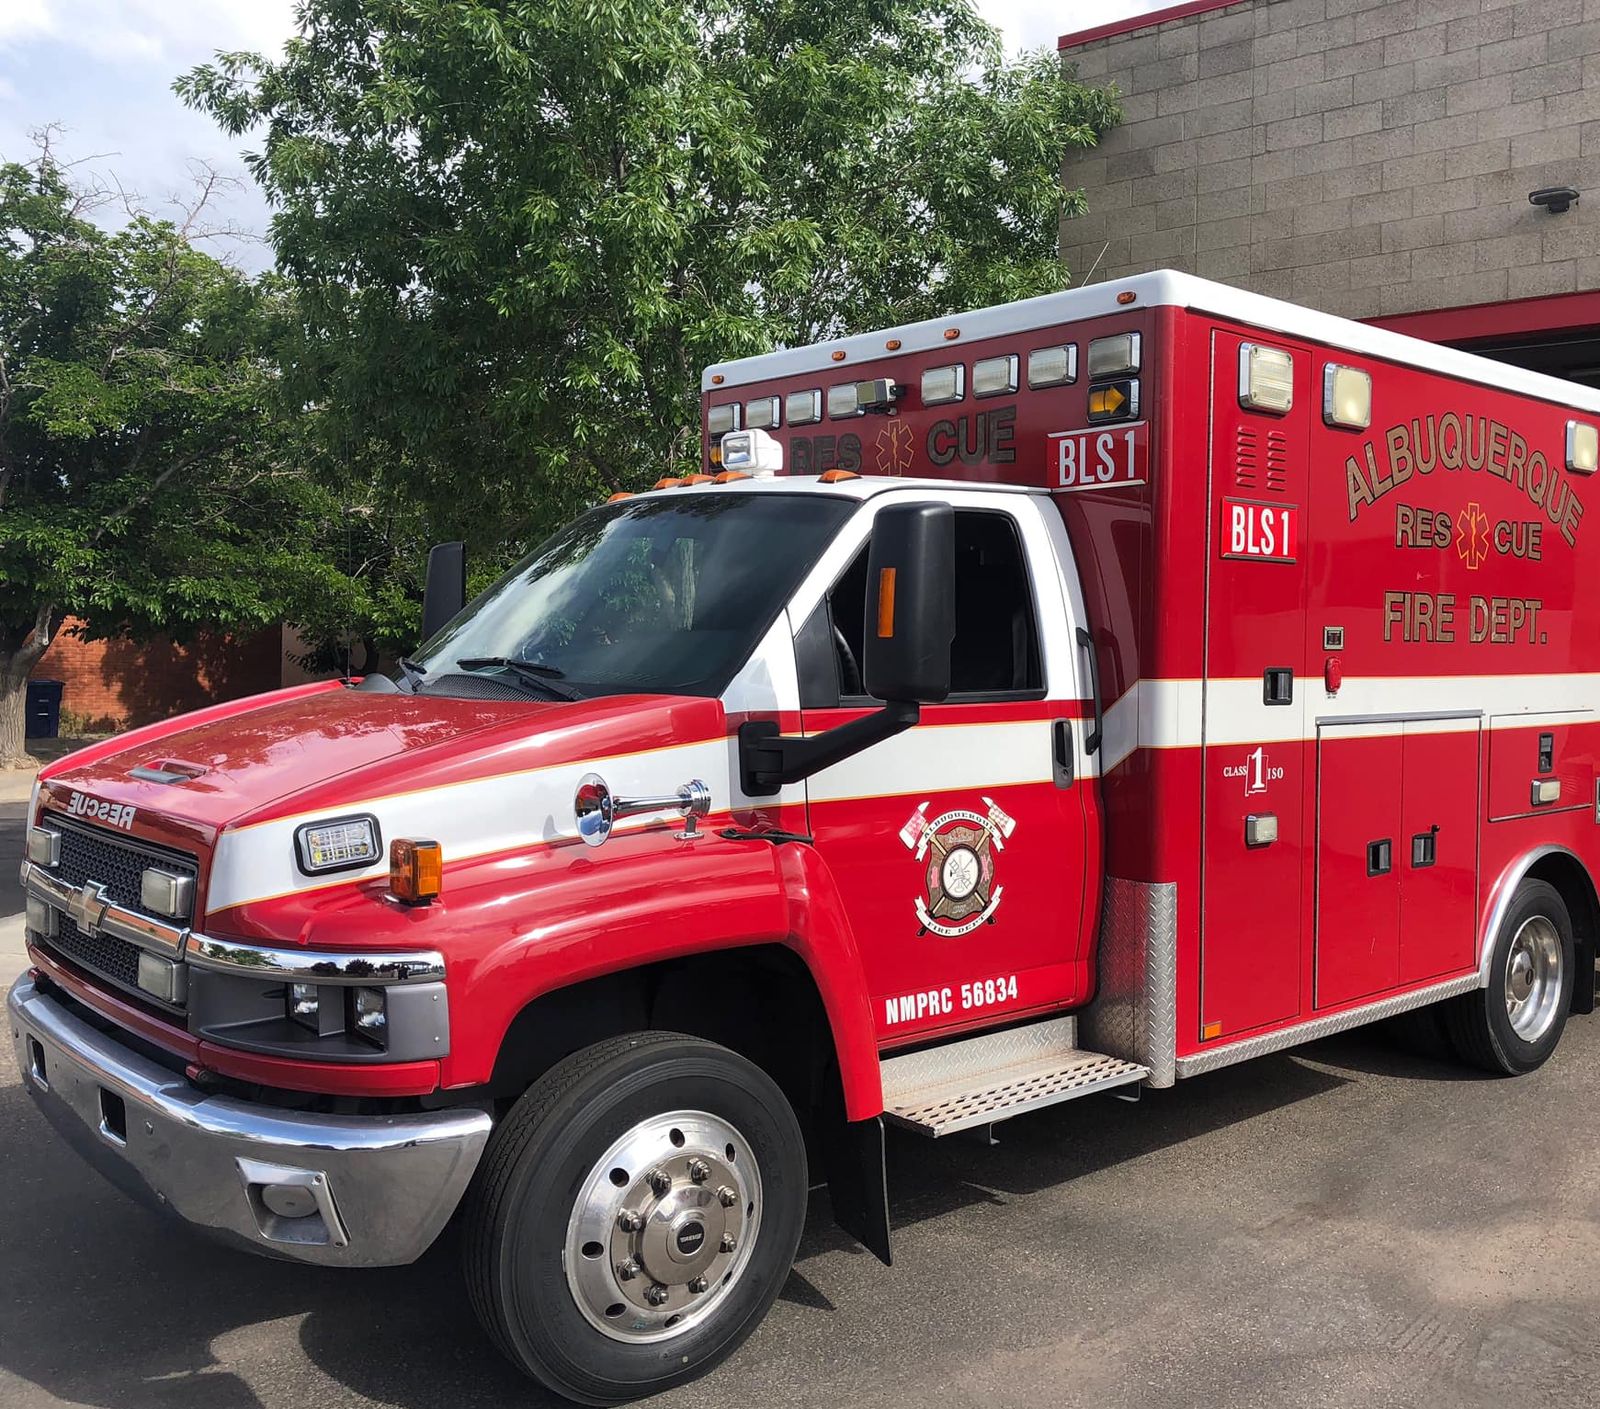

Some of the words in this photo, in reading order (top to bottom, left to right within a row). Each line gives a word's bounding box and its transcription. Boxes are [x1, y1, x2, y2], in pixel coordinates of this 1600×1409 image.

[790, 433, 862, 475] RES
[926, 405, 1017, 467] CUE
[1058, 433, 1116, 486] BLS
[1123, 430, 1136, 479] 1
[1345, 412, 1584, 547] ALBUQUERQUE
[1232, 505, 1275, 555] BLS
[1280, 509, 1290, 557] 1
[1395, 503, 1453, 549] RES
[1493, 520, 1543, 561] CUE
[1383, 590, 1456, 643] FIRE
[1469, 596, 1548, 645] DEPT.
[1223, 765, 1248, 777] CLASS
[1251, 746, 1266, 789] 1
[1267, 767, 1284, 780] ISO
[924, 811, 996, 839] ALBUQUERQUE
[927, 921, 952, 935] FIRE
[885, 988, 953, 1025] NMPRC
[961, 975, 1019, 1009] 56834
